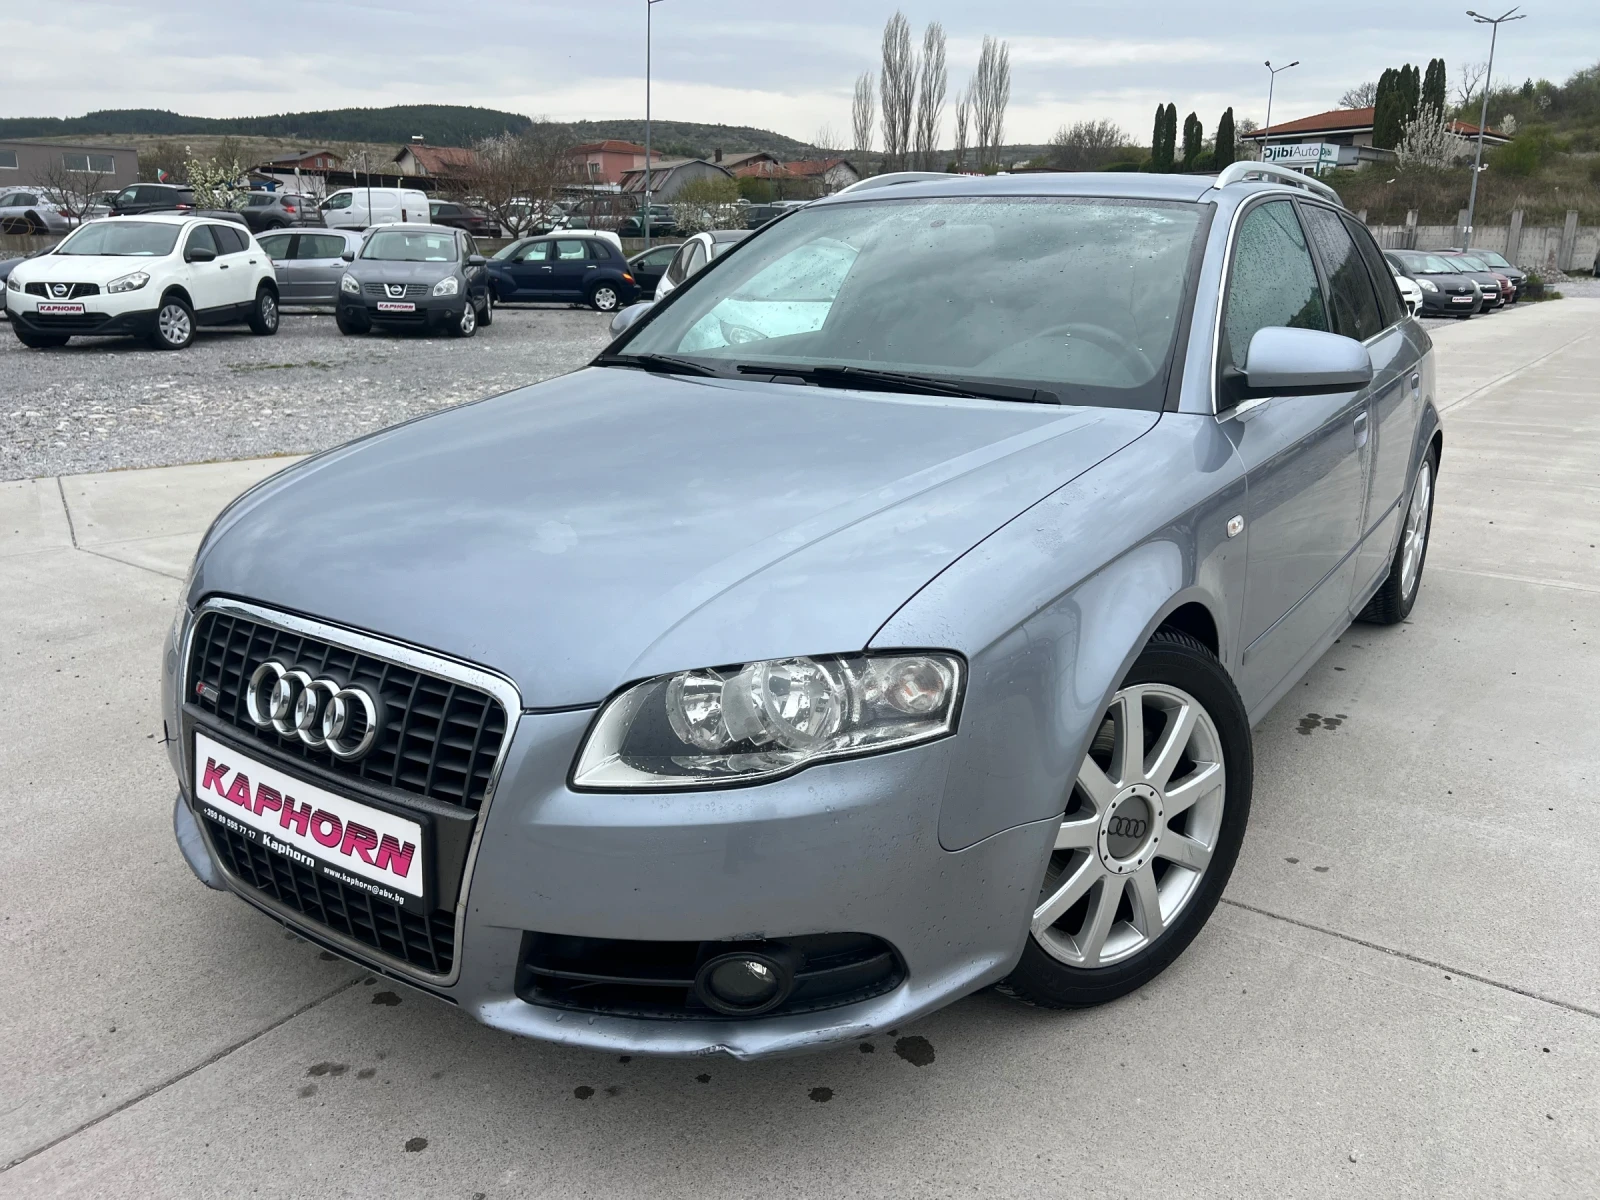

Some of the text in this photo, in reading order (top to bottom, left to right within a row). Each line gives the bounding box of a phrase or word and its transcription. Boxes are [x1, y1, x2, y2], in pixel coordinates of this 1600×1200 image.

[202, 757, 416, 878] KAPHORN
[239, 824, 247, 835] 77
[248, 829, 256, 839] 17
[263, 833, 315, 868] Kaphorn
[323, 866, 405, 905] www.kaphorn@abv.bg
